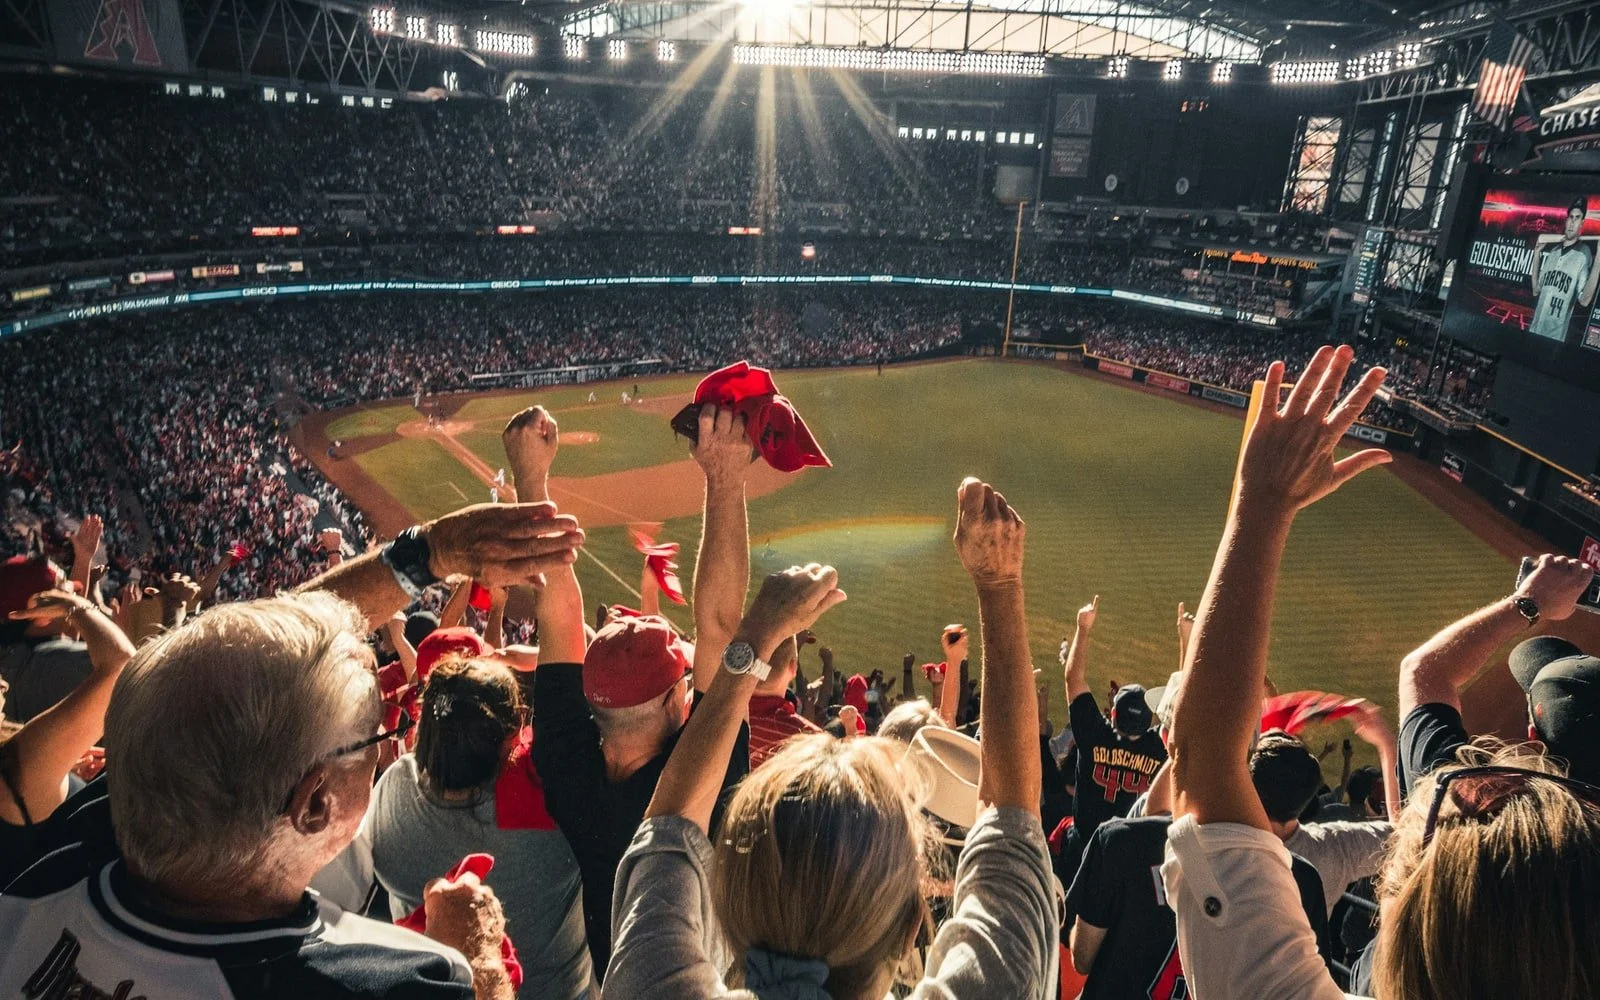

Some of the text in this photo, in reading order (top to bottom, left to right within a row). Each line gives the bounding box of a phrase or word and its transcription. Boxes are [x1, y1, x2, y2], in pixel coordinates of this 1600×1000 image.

[1540, 105, 1600, 136] CHASE
[242, 286, 278, 297] GEICO
[490, 280, 520, 289] GEICO
[1050, 285, 1076, 293] GEICO
[1550, 296, 1565, 318] 44
[1347, 424, 1384, 443] EICO
[1093, 746, 1161, 775] GOLDSCHMIDT
[1092, 764, 1151, 803] 44
